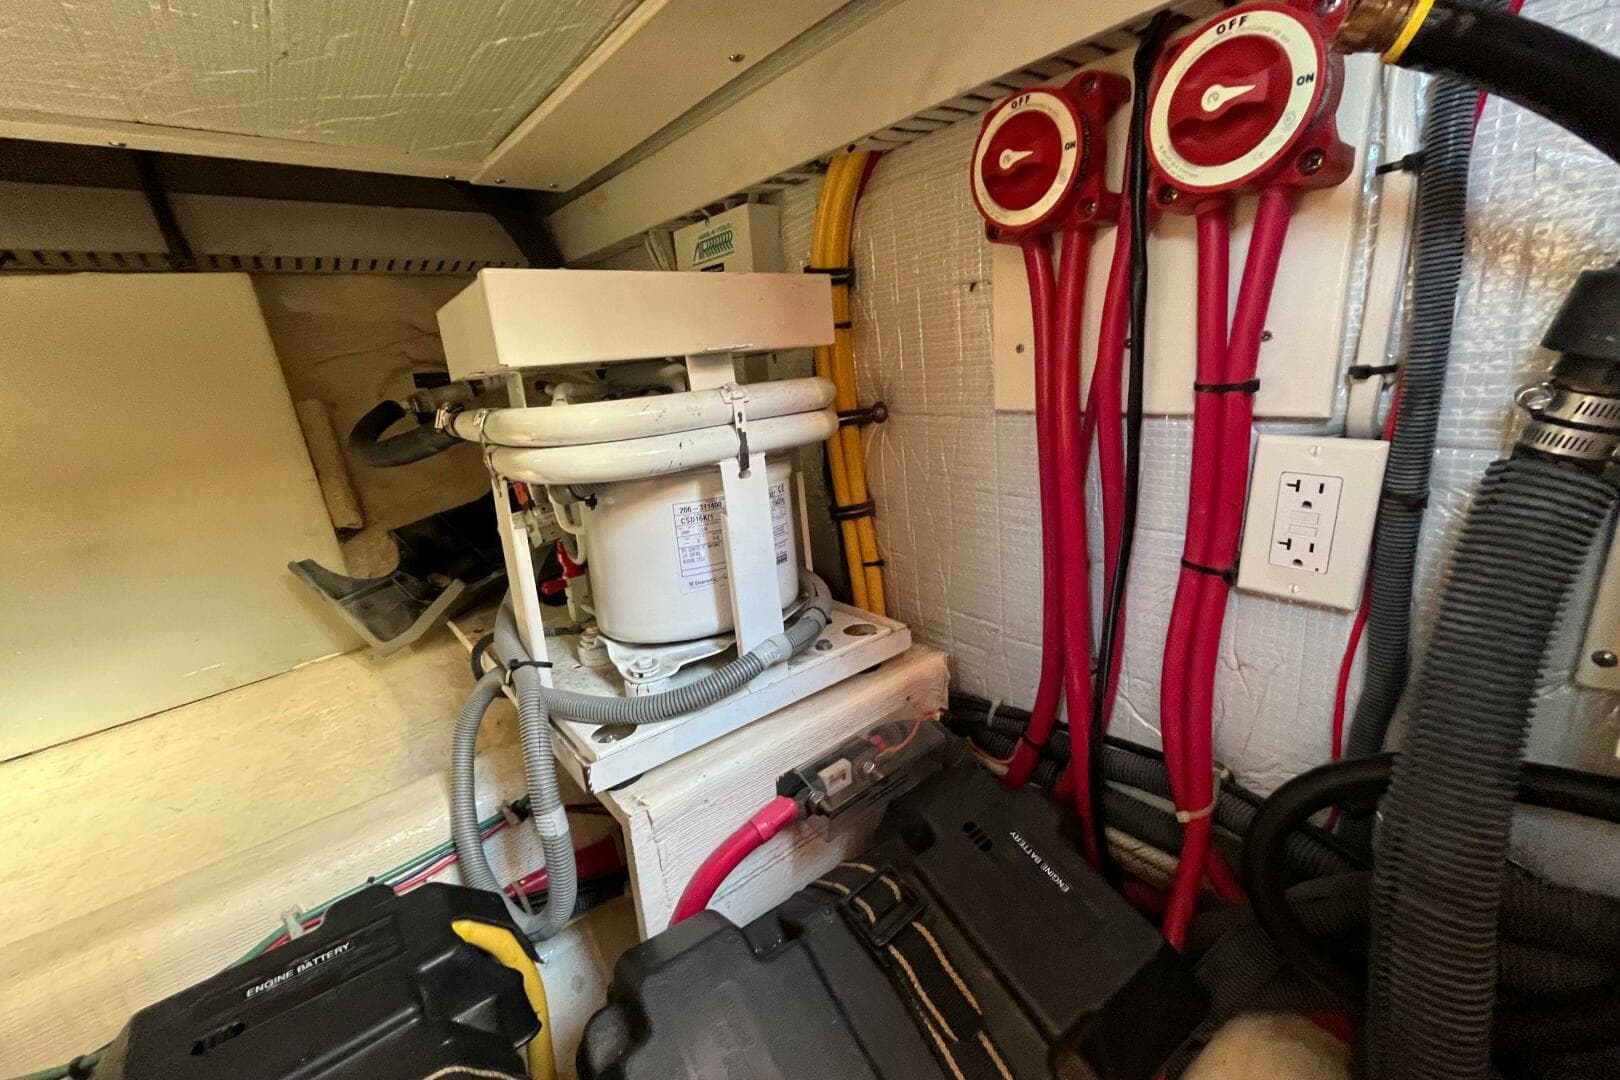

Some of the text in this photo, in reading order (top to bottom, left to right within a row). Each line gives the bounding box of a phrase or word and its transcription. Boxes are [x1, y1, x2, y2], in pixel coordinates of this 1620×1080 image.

[1216, 15, 1249, 35] OFF
[1296, 72, 1315, 86] ON
[1010, 95, 1031, 109] OFF
[1064, 141, 1076, 151] ON
[1009, 831, 1069, 892] ENGINE BATTERY
[246, 942, 350, 998] ENGINE BATTERY
